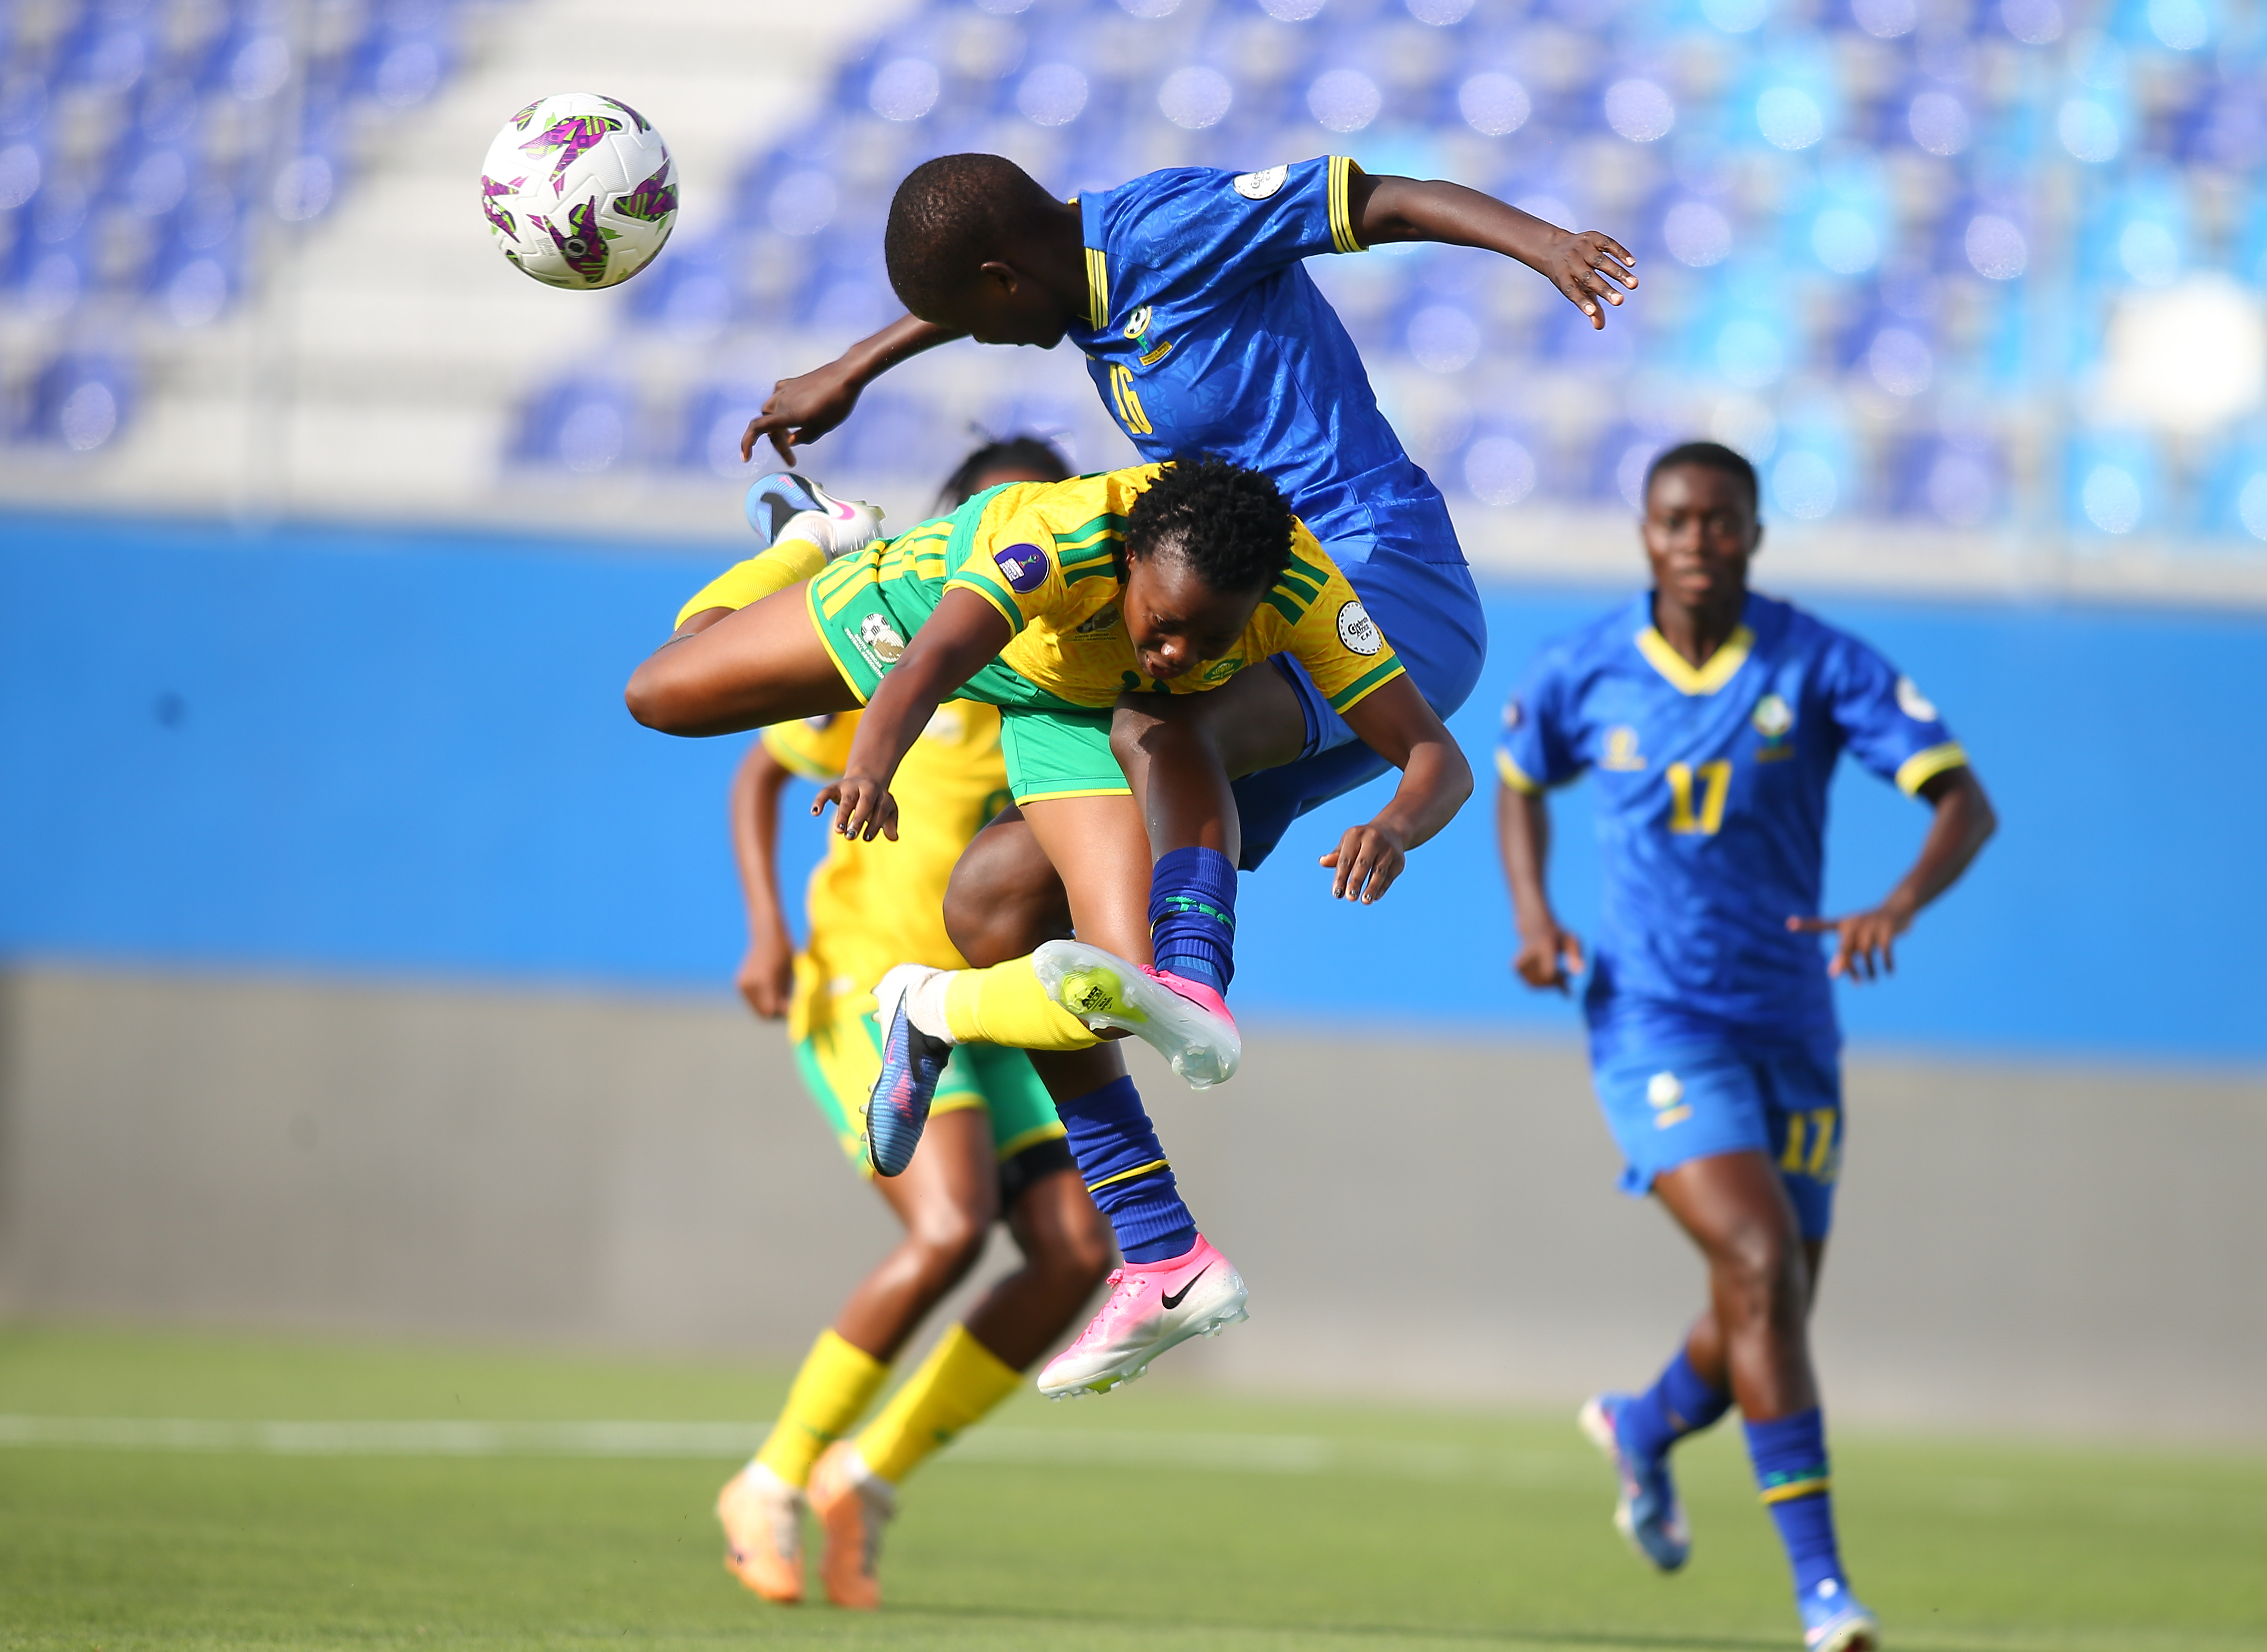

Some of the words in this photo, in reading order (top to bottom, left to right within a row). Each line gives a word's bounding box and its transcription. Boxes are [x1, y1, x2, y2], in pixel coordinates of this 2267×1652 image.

[1110, 364, 1153, 434] 16
[845, 628, 862, 652] FOOTBALL
[855, 633, 867, 650] SOUTH
[866, 649, 882, 669] AFRICAN
[1361, 630, 1372, 641] CAF
[1666, 759, 1731, 834] 17
[1780, 1109, 1836, 1177] 17
